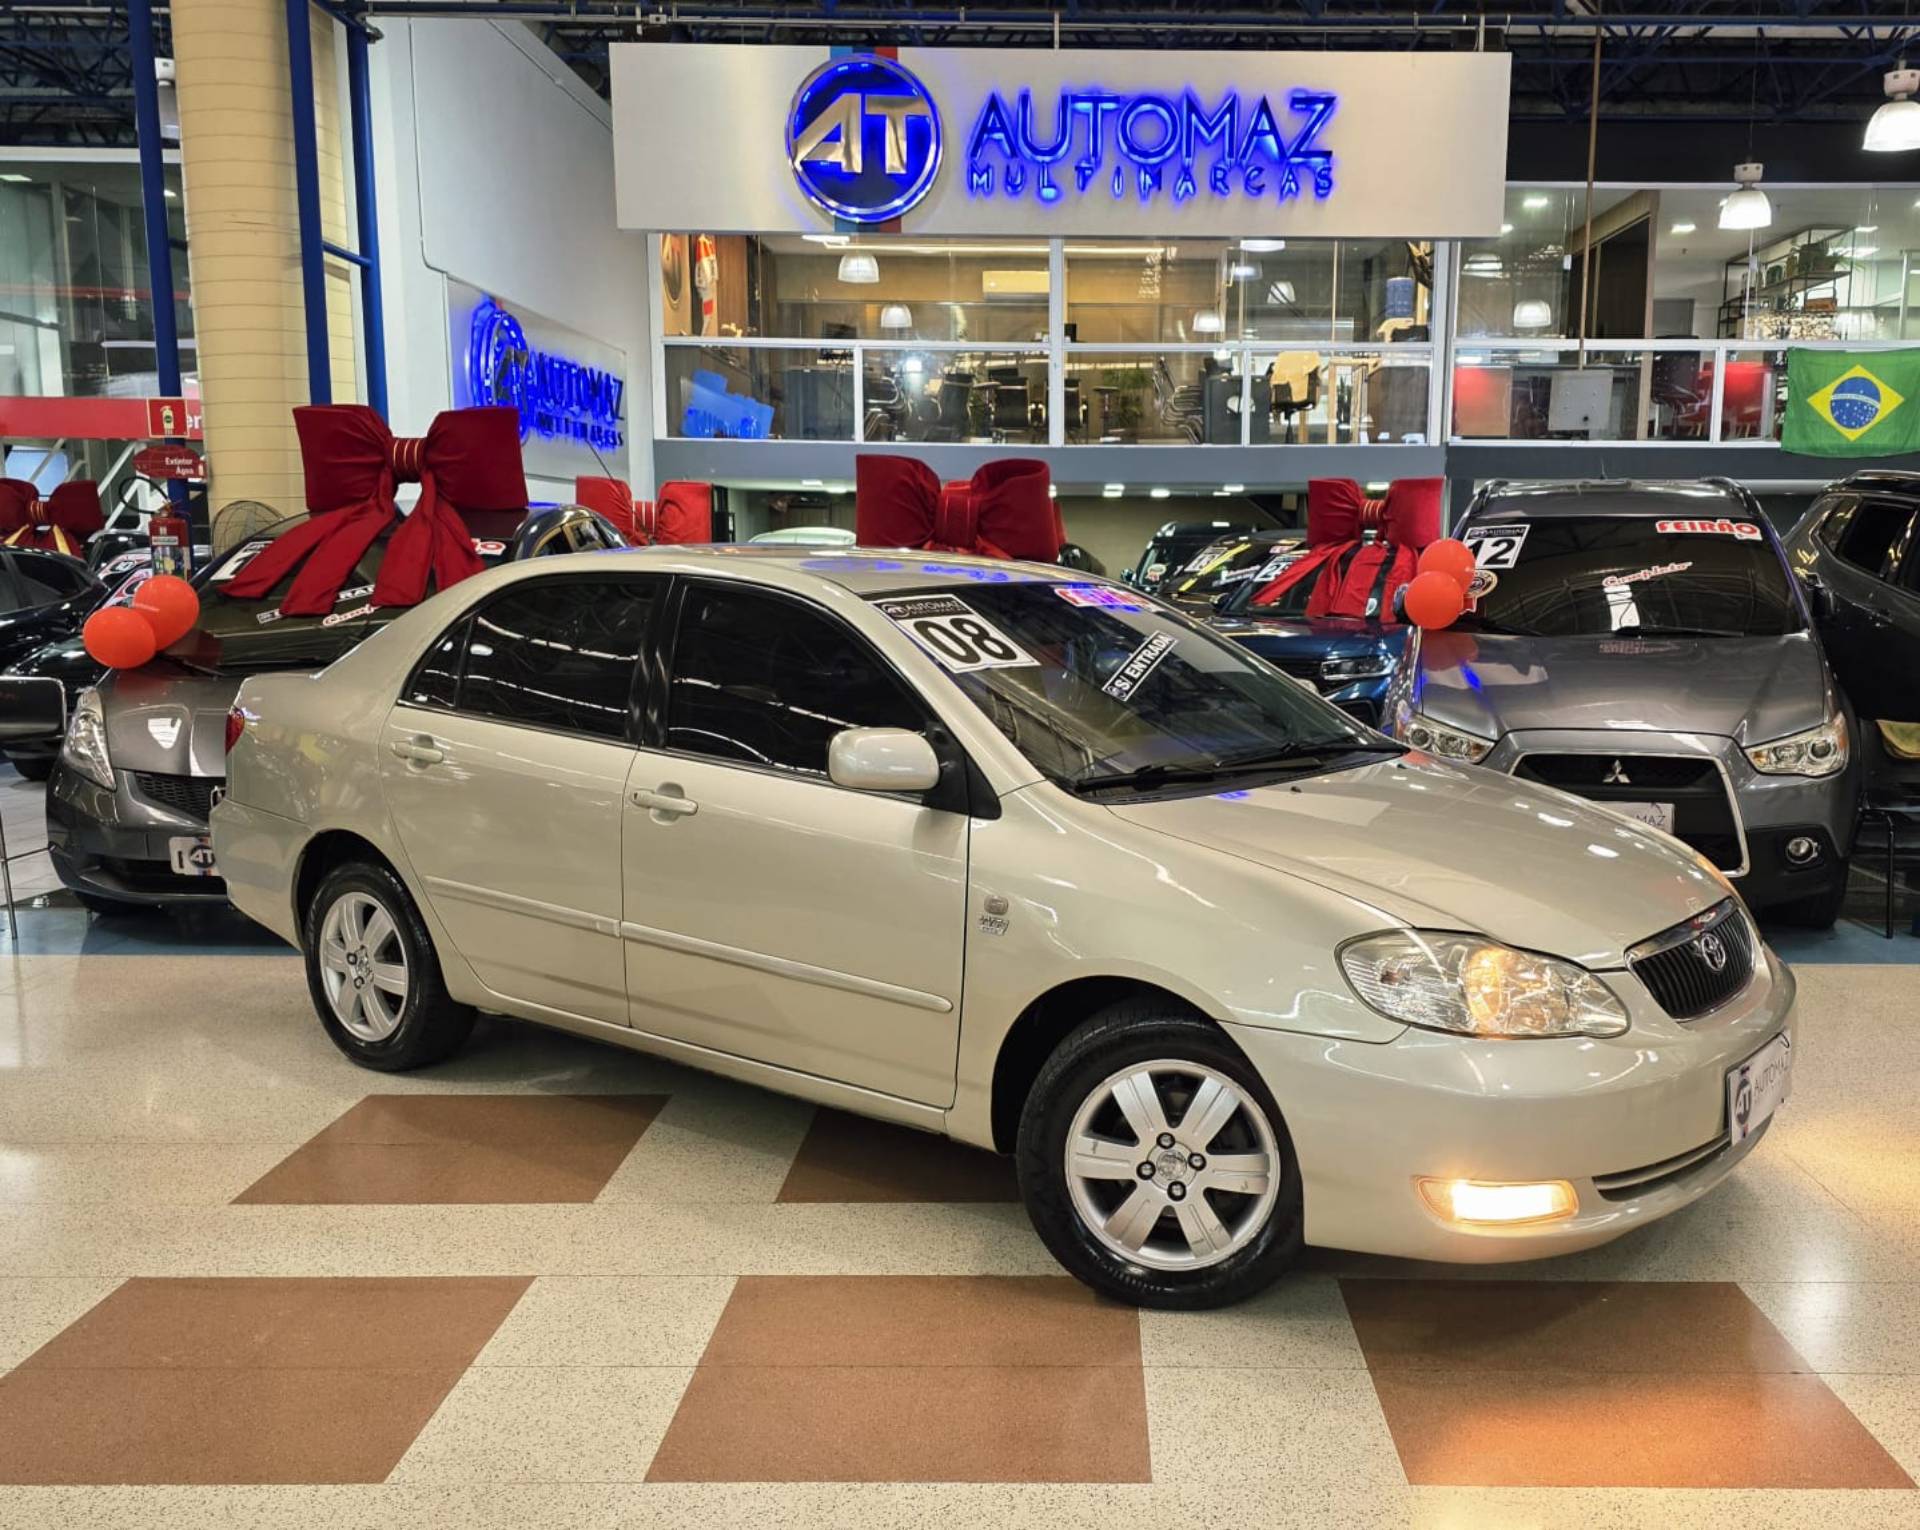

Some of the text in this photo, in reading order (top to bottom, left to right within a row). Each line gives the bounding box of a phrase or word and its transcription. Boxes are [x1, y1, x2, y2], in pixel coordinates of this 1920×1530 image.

[968, 90, 1338, 165] AUTOMAZ
[968, 160, 1334, 200] MULTIMARCAS
[1657, 519, 1758, 535] FEIRÃO
[1468, 538, 1516, 566] 12
[913, 618, 1017, 664] 08
[1124, 634, 1172, 680] ENTRADA
